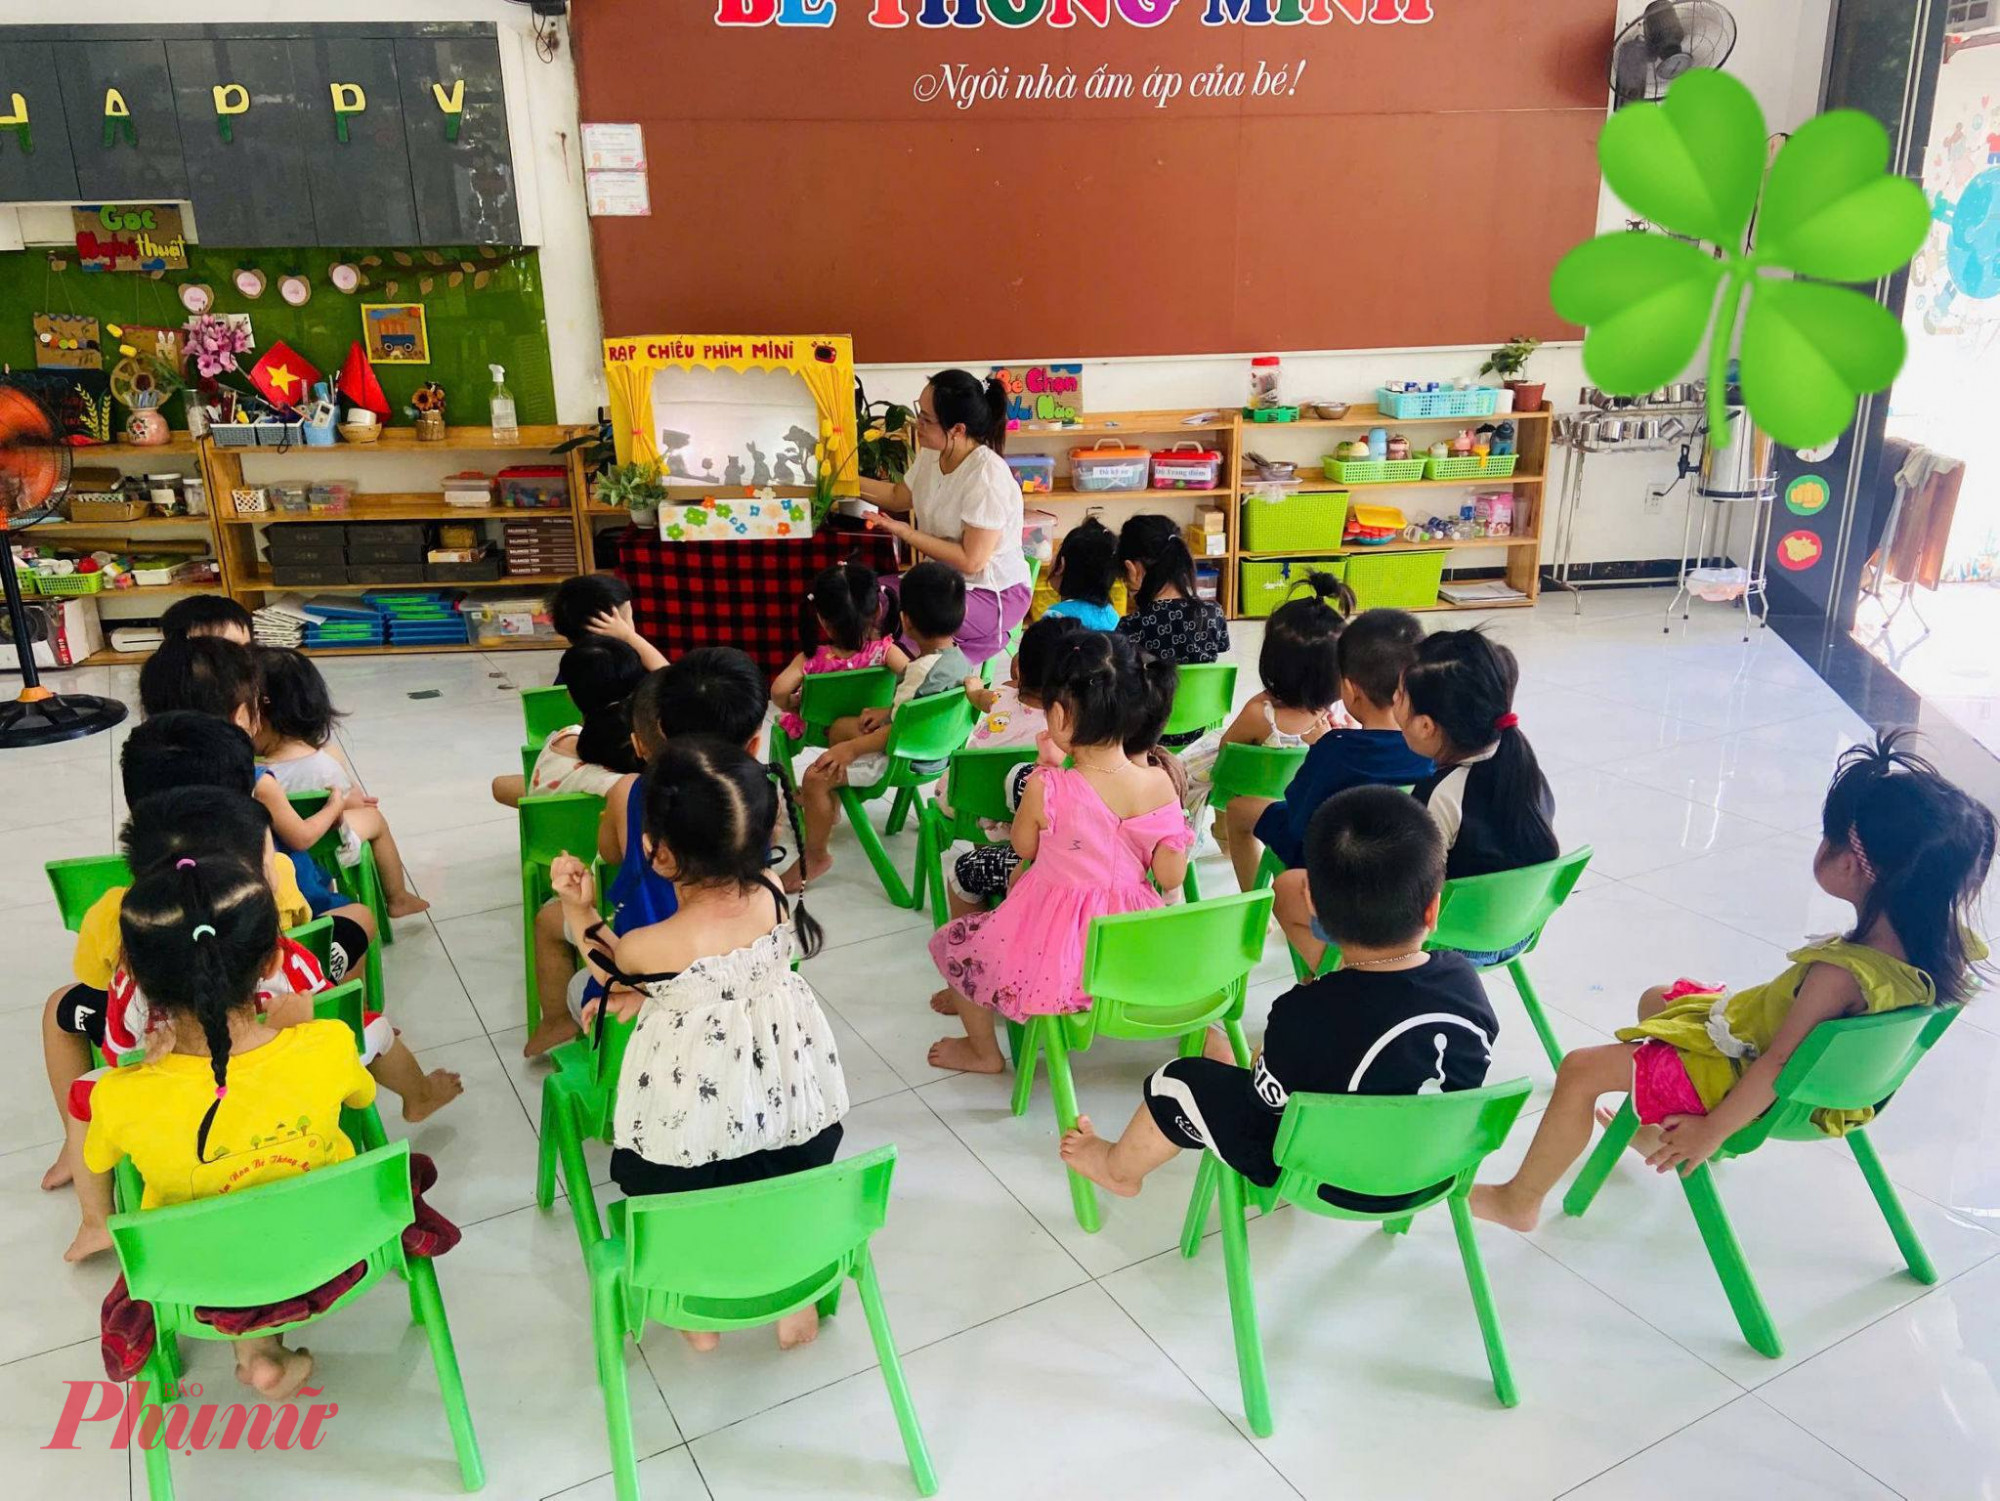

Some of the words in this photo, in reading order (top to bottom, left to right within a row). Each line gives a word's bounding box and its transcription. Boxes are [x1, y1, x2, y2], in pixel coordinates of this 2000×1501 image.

[913, 63, 1010, 110] Ngôi
[1015, 63, 1077, 99] nhà
[1084, 62, 1135, 98] ấm
[1142, 65, 1183, 109] áp
[1190, 63, 1246, 97] của
[1251, 59, 1307, 97] bé!
